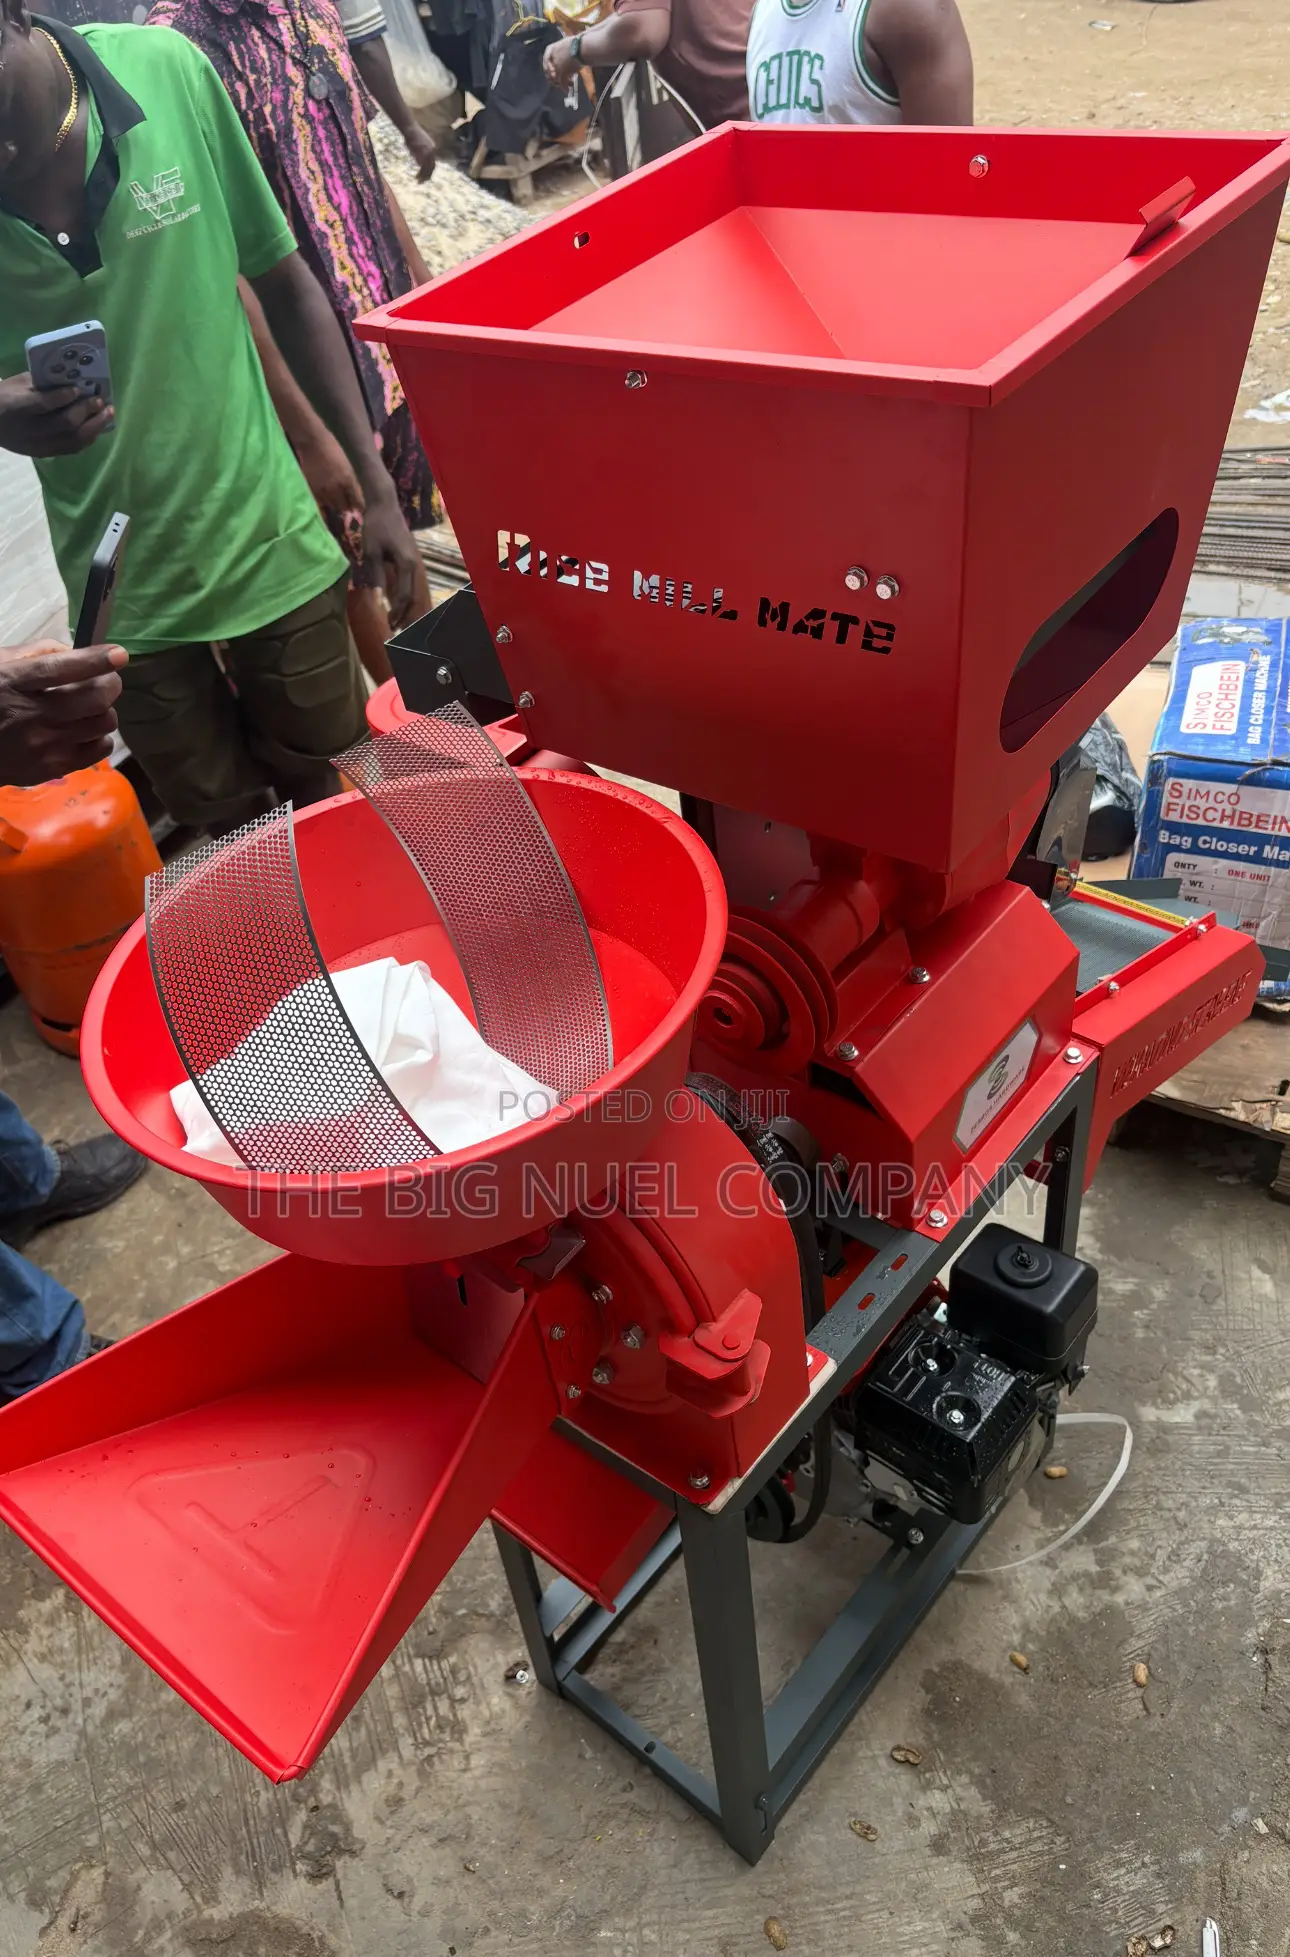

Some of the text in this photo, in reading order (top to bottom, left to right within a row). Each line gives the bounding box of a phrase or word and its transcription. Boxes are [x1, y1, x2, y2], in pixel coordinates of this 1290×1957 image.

[632, 568, 739, 622] MILL
[757, 595, 897, 656] MATE
[1185, 691, 1212, 730] SIMCO
[1211, 663, 1241, 732] FISCHBEIN
[1249, 691, 1266, 725] CLOSER
[1246, 725, 1262, 745] BAG
[1168, 782, 1241, 806] SIMCO
[1164, 802, 1290, 835] FISCHBEIN
[1159, 829, 1192, 849] Bag
[1198, 836, 1258, 856] Closer
[1227, 869, 1248, 878] ONE
[1249, 872, 1271, 881] UNIT
